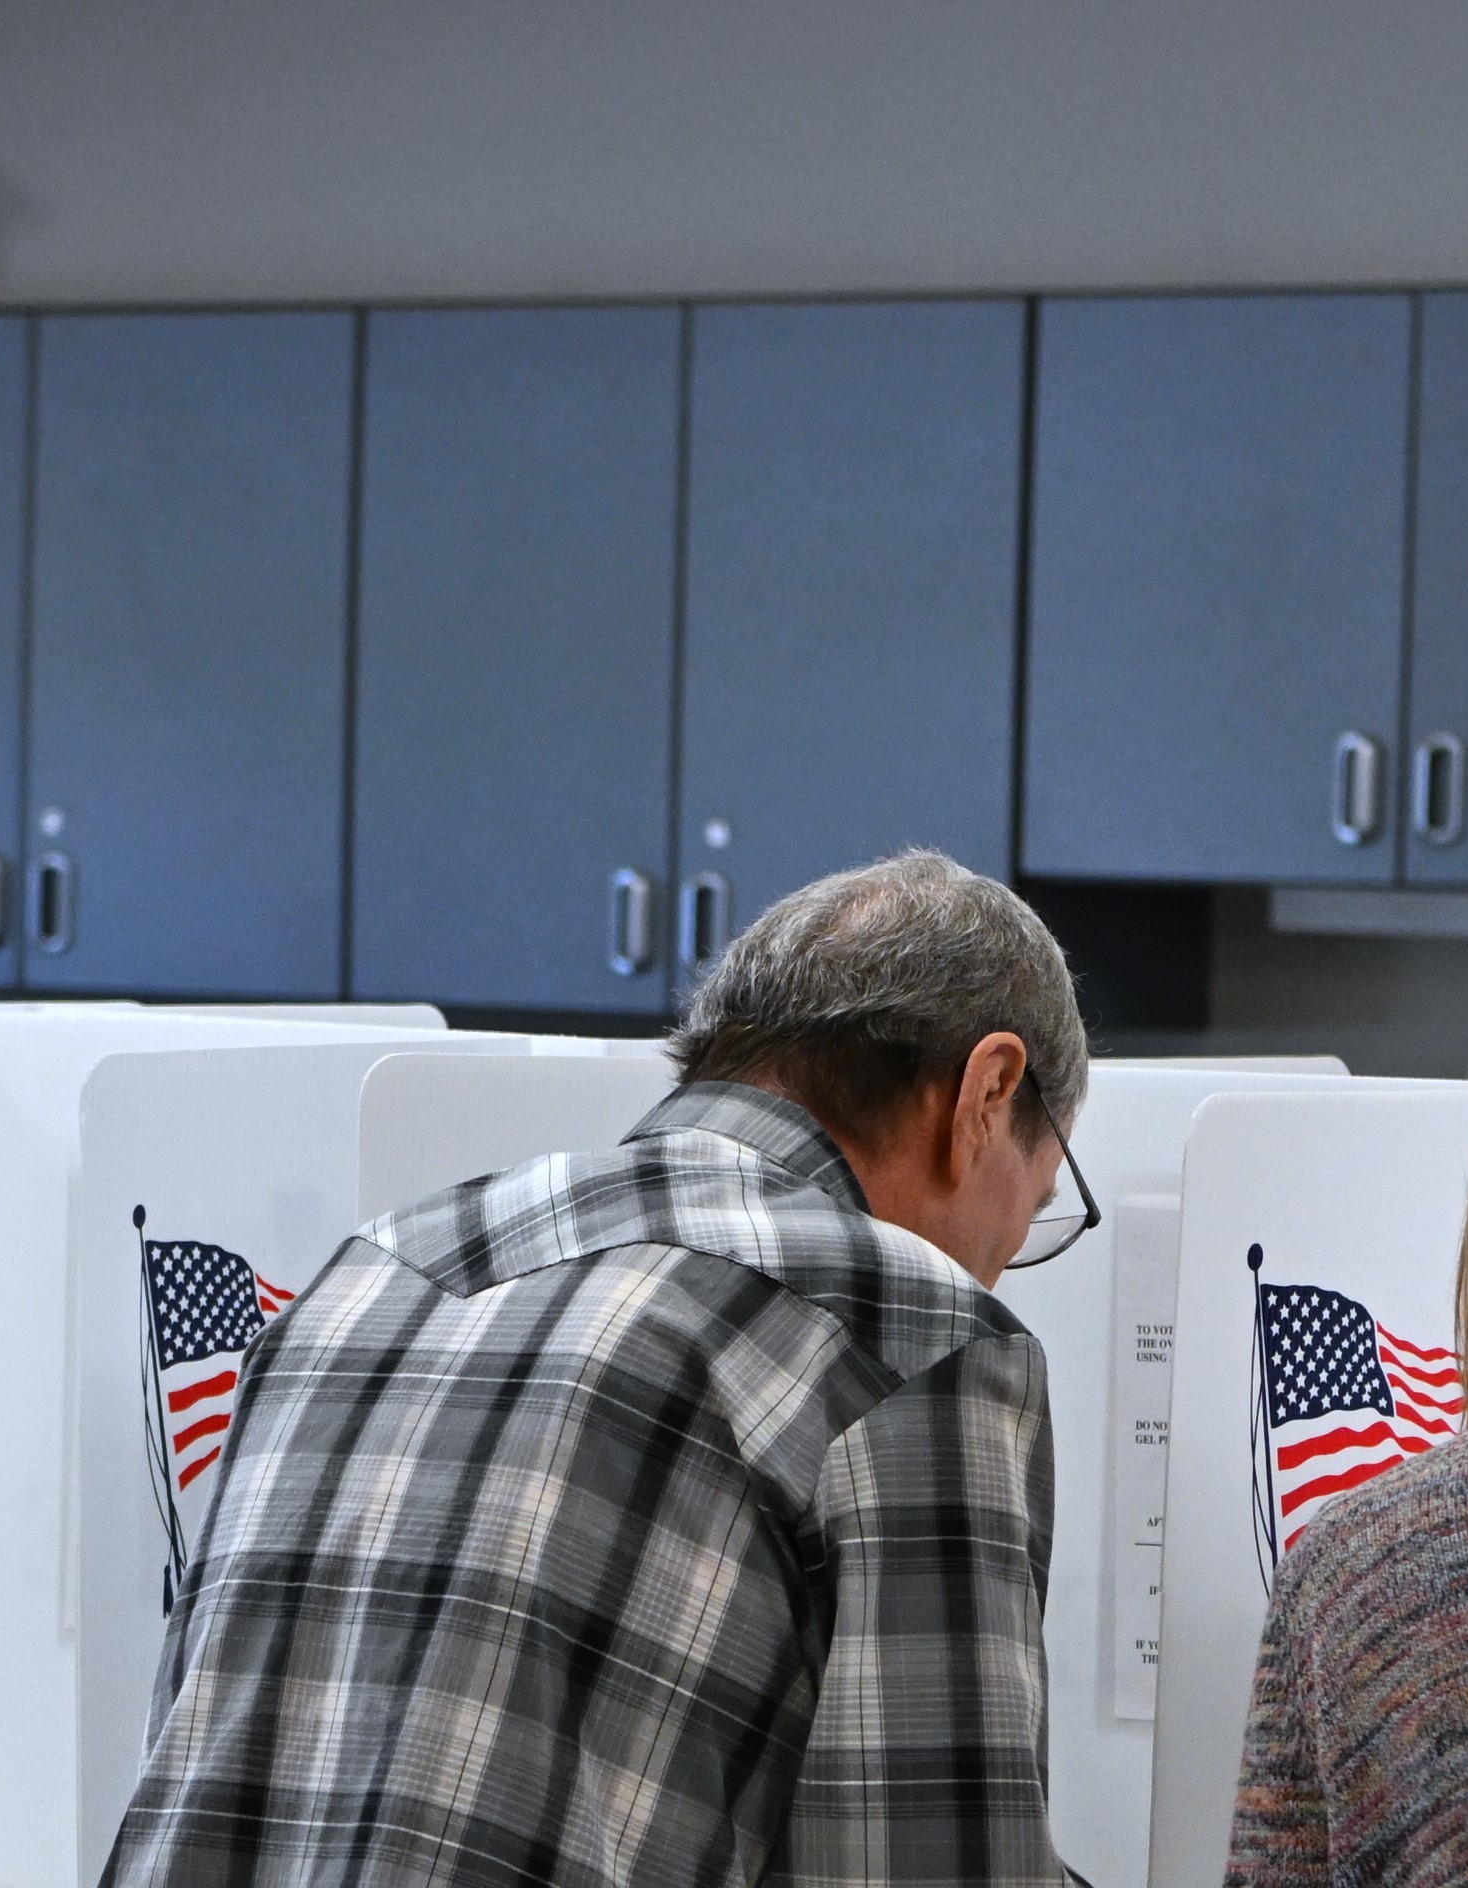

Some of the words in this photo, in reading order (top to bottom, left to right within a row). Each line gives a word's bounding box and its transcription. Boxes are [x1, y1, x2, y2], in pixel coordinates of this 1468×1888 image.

[1136, 1324, 1151, 1335] TO
[1136, 1338, 1157, 1349] THE
[1136, 1352, 1167, 1363] USING
[1135, 1420, 1150, 1431] DO
[1135, 1434, 1156, 1445] GEL
[1136, 1639, 1146, 1650] IF
